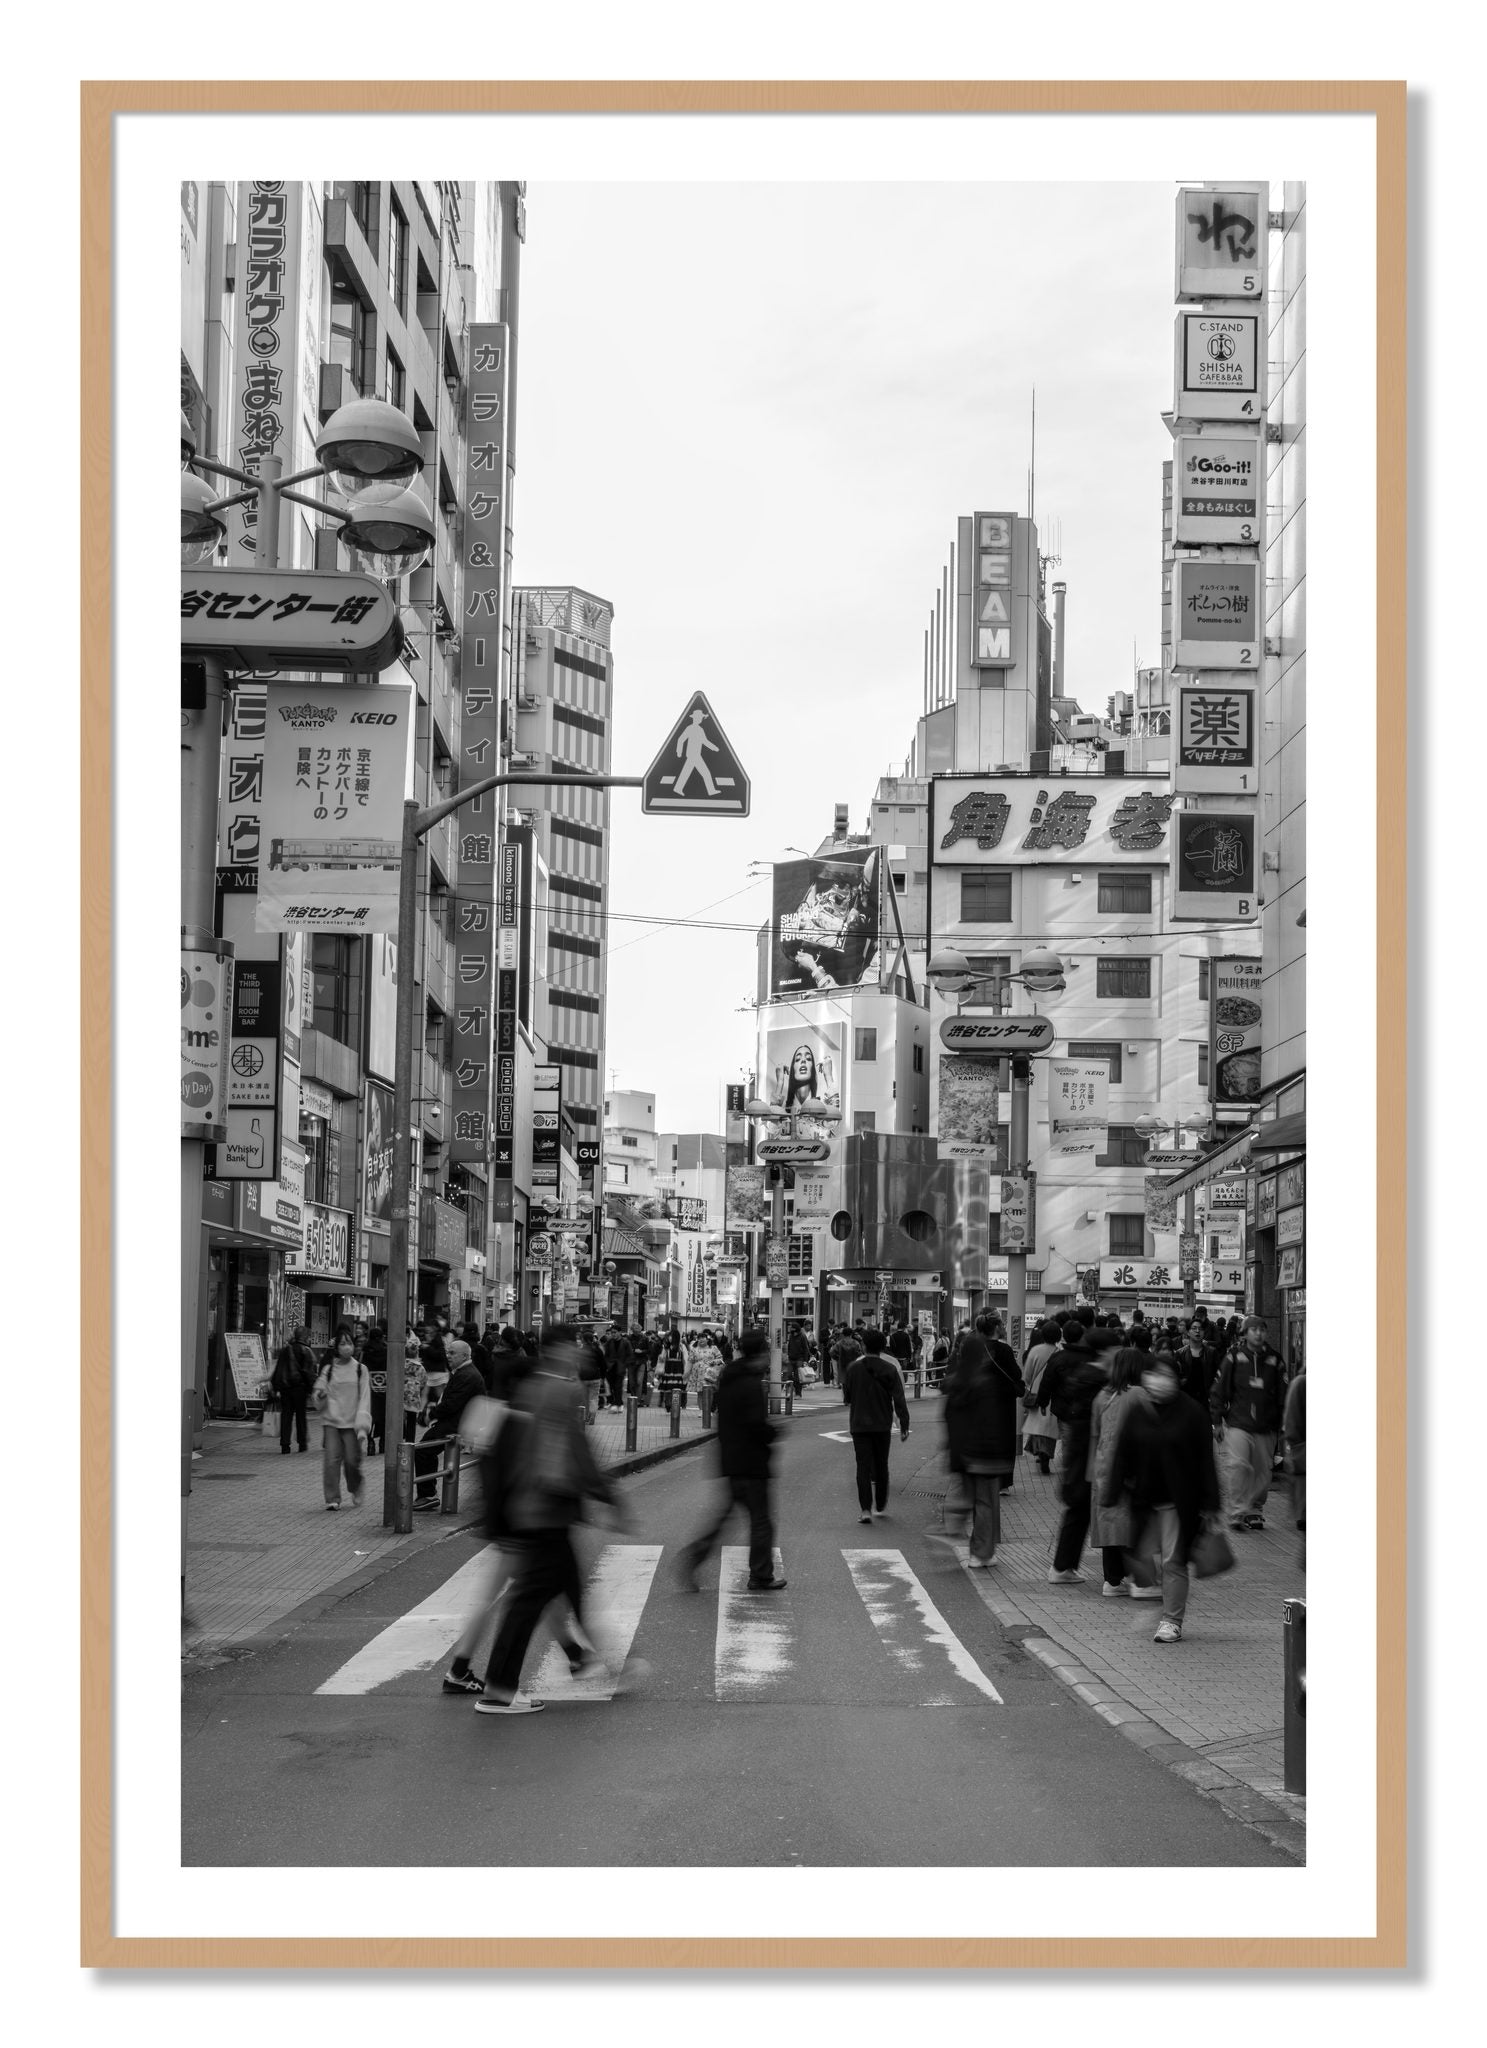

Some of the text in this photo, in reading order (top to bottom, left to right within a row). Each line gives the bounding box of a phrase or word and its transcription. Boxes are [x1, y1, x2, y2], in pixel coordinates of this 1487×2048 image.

[246, 193, 287, 328] カラオケ
[1243, 276, 1254, 291] 5
[1200, 322, 1243, 332] C.STAND
[1200, 363, 1243, 372] SHISHA
[1200, 373, 1243, 381] CAFE&BAR
[1241, 399, 1253, 415] 4
[1198, 458, 1251, 474] Goo-it!
[1191, 477, 1248, 486] 渋谷宇田川町店
[1186, 502, 1252, 513] 全身もみほぐし
[1240, 524, 1252, 540] 3
[979, 516, 1011, 659] BEAM
[1240, 649, 1251, 664] 2
[350, 712, 398, 726] KEIO
[1190, 696, 1240, 746] 薬
[296, 747, 312, 789] 冒険へ
[314, 747, 331, 820] カントーの
[334, 748, 352, 820] ポケパーク
[355, 749, 372, 806] 京王線で
[1240, 774, 1248, 789] 1
[940, 790, 1175, 850] 角海老
[1185, 828, 1244, 877] 一蘭
[505, 849, 515, 922] kimono hearts
[283, 906, 370, 919] 渋谷センター街
[1239, 900, 1250, 915] B
[1218, 977, 1262, 990] 四川料理
[454, 903, 488, 1141] カラオケ館
[947, 1023, 1048, 1039] 渋谷センター街
[1216, 1033, 1244, 1053] 6F
[192, 1081, 211, 1095] Day!
[227, 1144, 260, 1155] Whisky
[579, 1148, 599, 1158] GU
[760, 1145, 821, 1154] 渋谷センター街
[226, 1154, 246, 1162] Bank
[695, 1263, 703, 1305] BEER
